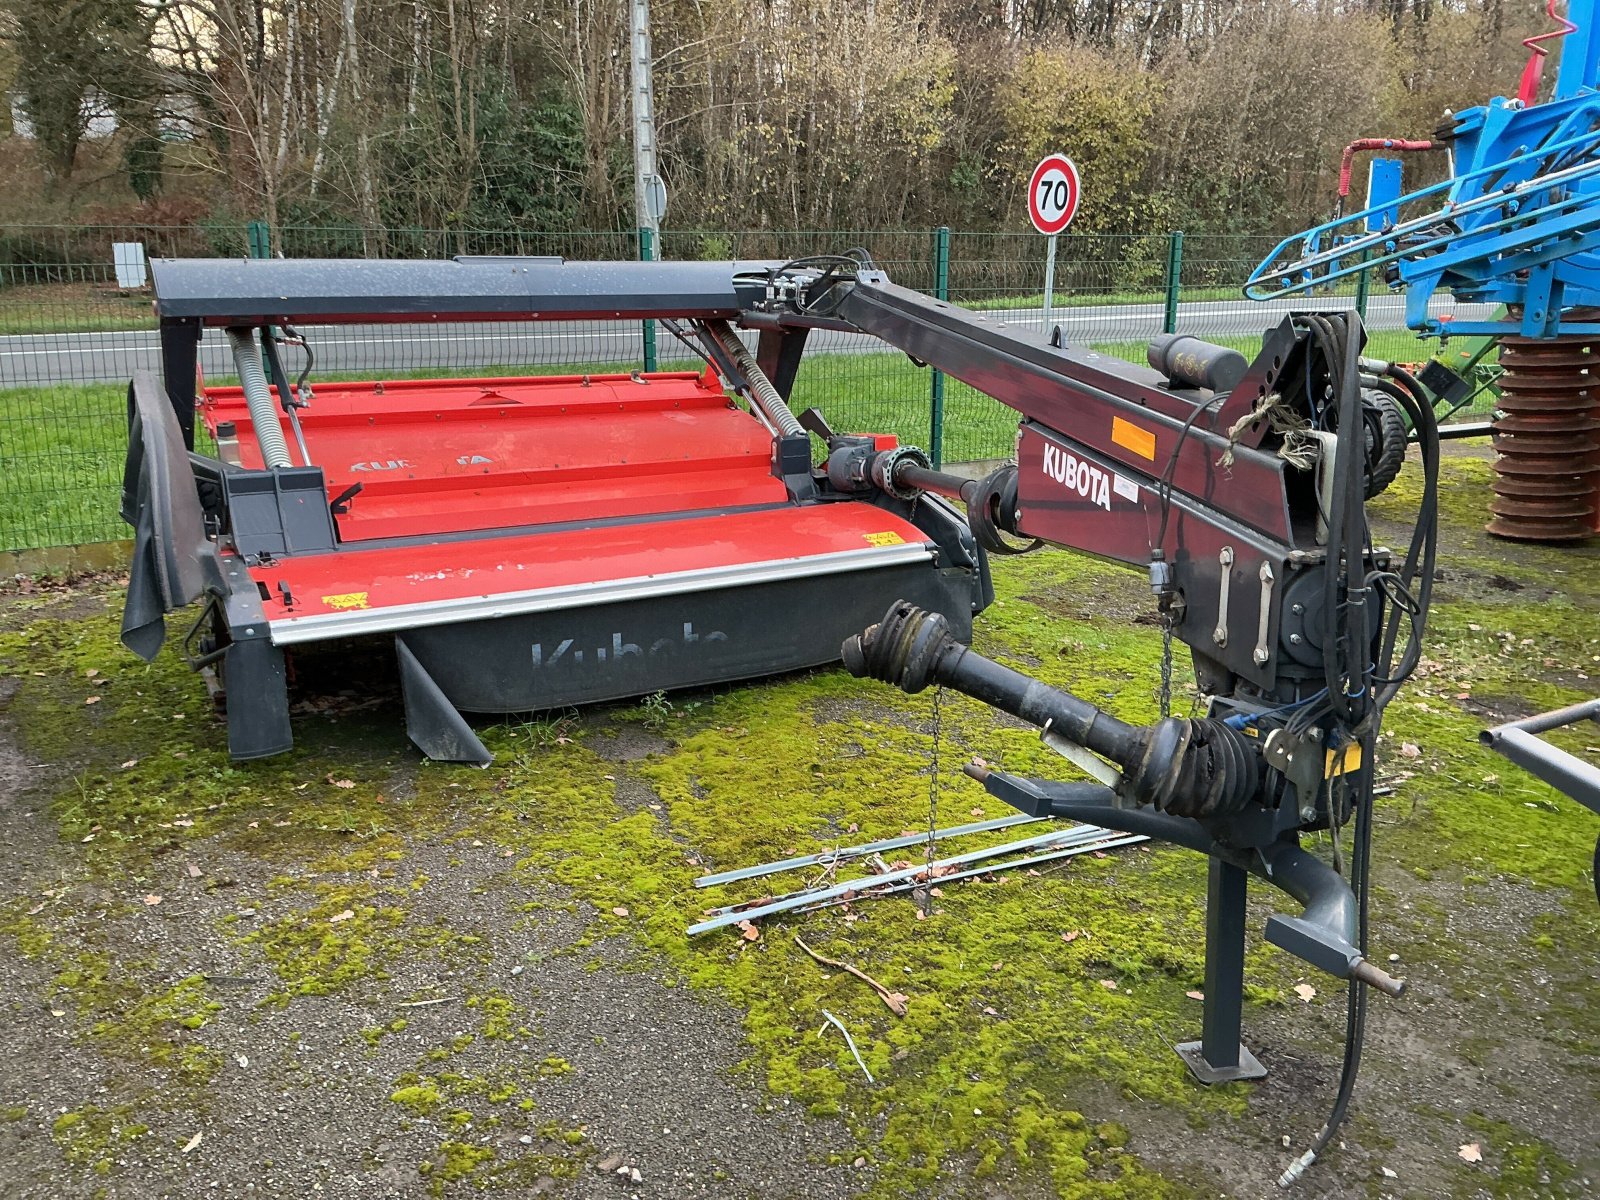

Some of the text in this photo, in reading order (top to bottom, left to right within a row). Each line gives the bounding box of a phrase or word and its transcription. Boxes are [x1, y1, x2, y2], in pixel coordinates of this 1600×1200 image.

[1041, 181, 1068, 210] 70
[350, 455, 493, 473] KUTA
[1043, 442, 1110, 511] KUBOTA
[531, 622, 728, 667] Kbt
